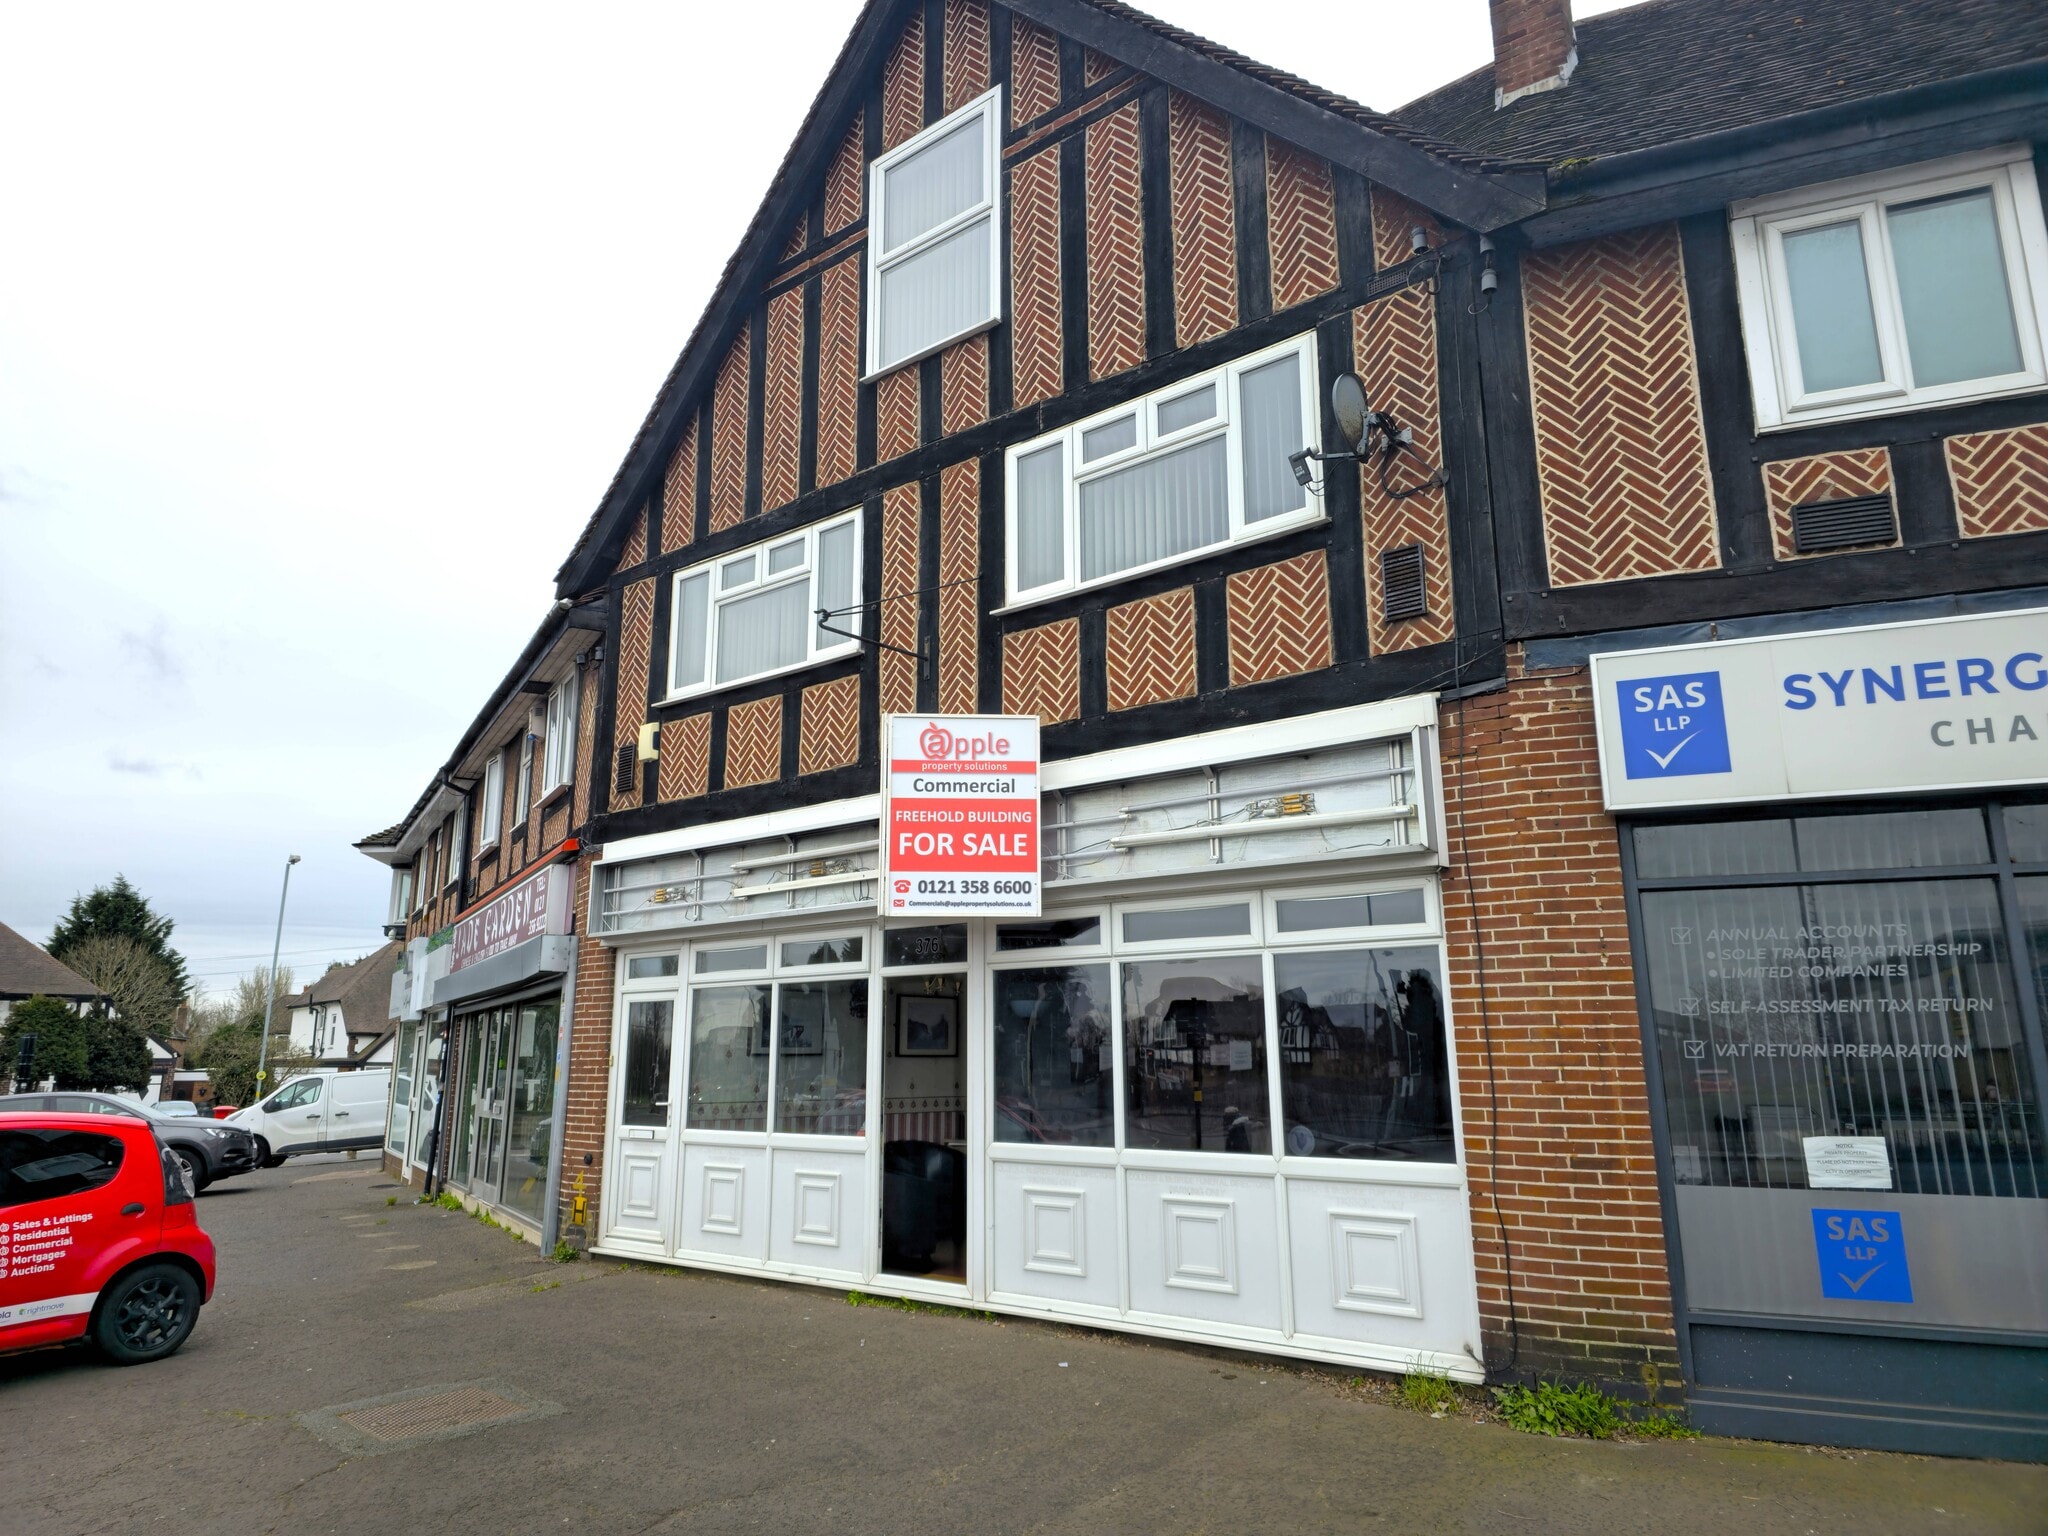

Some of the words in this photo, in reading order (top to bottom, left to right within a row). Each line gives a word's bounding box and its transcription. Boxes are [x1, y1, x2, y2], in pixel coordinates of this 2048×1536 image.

[1783, 651, 2048, 711] SYNERG
[1634, 681, 1707, 713] SAS
[1654, 715, 1691, 732] LLP
[1931, 713, 2048, 747] CHA
[920, 723, 1010, 760] apple
[921, 761, 962, 772] property
[964, 762, 1008, 771] solutions
[913, 778, 1015, 794] Commercial
[896, 810, 965, 823] FREEHOLD
[968, 811, 1032, 823] BUILDING
[899, 833, 954, 856] FOR
[962, 833, 1028, 857] SALE
[918, 880, 956, 895] 0121
[961, 880, 989, 895] 358
[993, 880, 1032, 895] 6600
[909, 900, 1032, 908] Commercials@applepropertysolutions.co.uk
[456, 918, 480, 958] JADE
[485, 885, 532, 945] GARDEN
[1706, 927, 1790, 941] ANNUAL
[1795, 923, 1908, 939] ACCOUNTS
[915, 936, 940, 954] 376
[1721, 948, 1767, 960] SOLE
[1850, 943, 1982, 958] PARTNERSHIP
[1721, 966, 1793, 979] LIMITED
[1798, 964, 1908, 978] COMPANIES
[1710, 999, 1874, 1014] SELF-ASSESSMENT
[1878, 998, 1913, 1013] TAX
[1918, 998, 1993, 1012] RETURN
[1716, 1043, 1749, 1057] VAT
[1754, 1043, 1827, 1058] RETURN
[1833, 1044, 1968, 1058] PREPARATION
[13, 1221, 41, 1230] Sales
[43, 1217, 51, 1226] &
[53, 1213, 93, 1225] Lettings
[1826, 1216, 1890, 1243] SAS
[14, 1227, 69, 1242] Residential
[13, 1237, 73, 1253] Commercial
[12, 1251, 66, 1265] Mortgages
[1844, 1247, 1877, 1260] LLP
[11, 1264, 55, 1277] Auctions
[27, 1303, 65, 1315] rightmove
